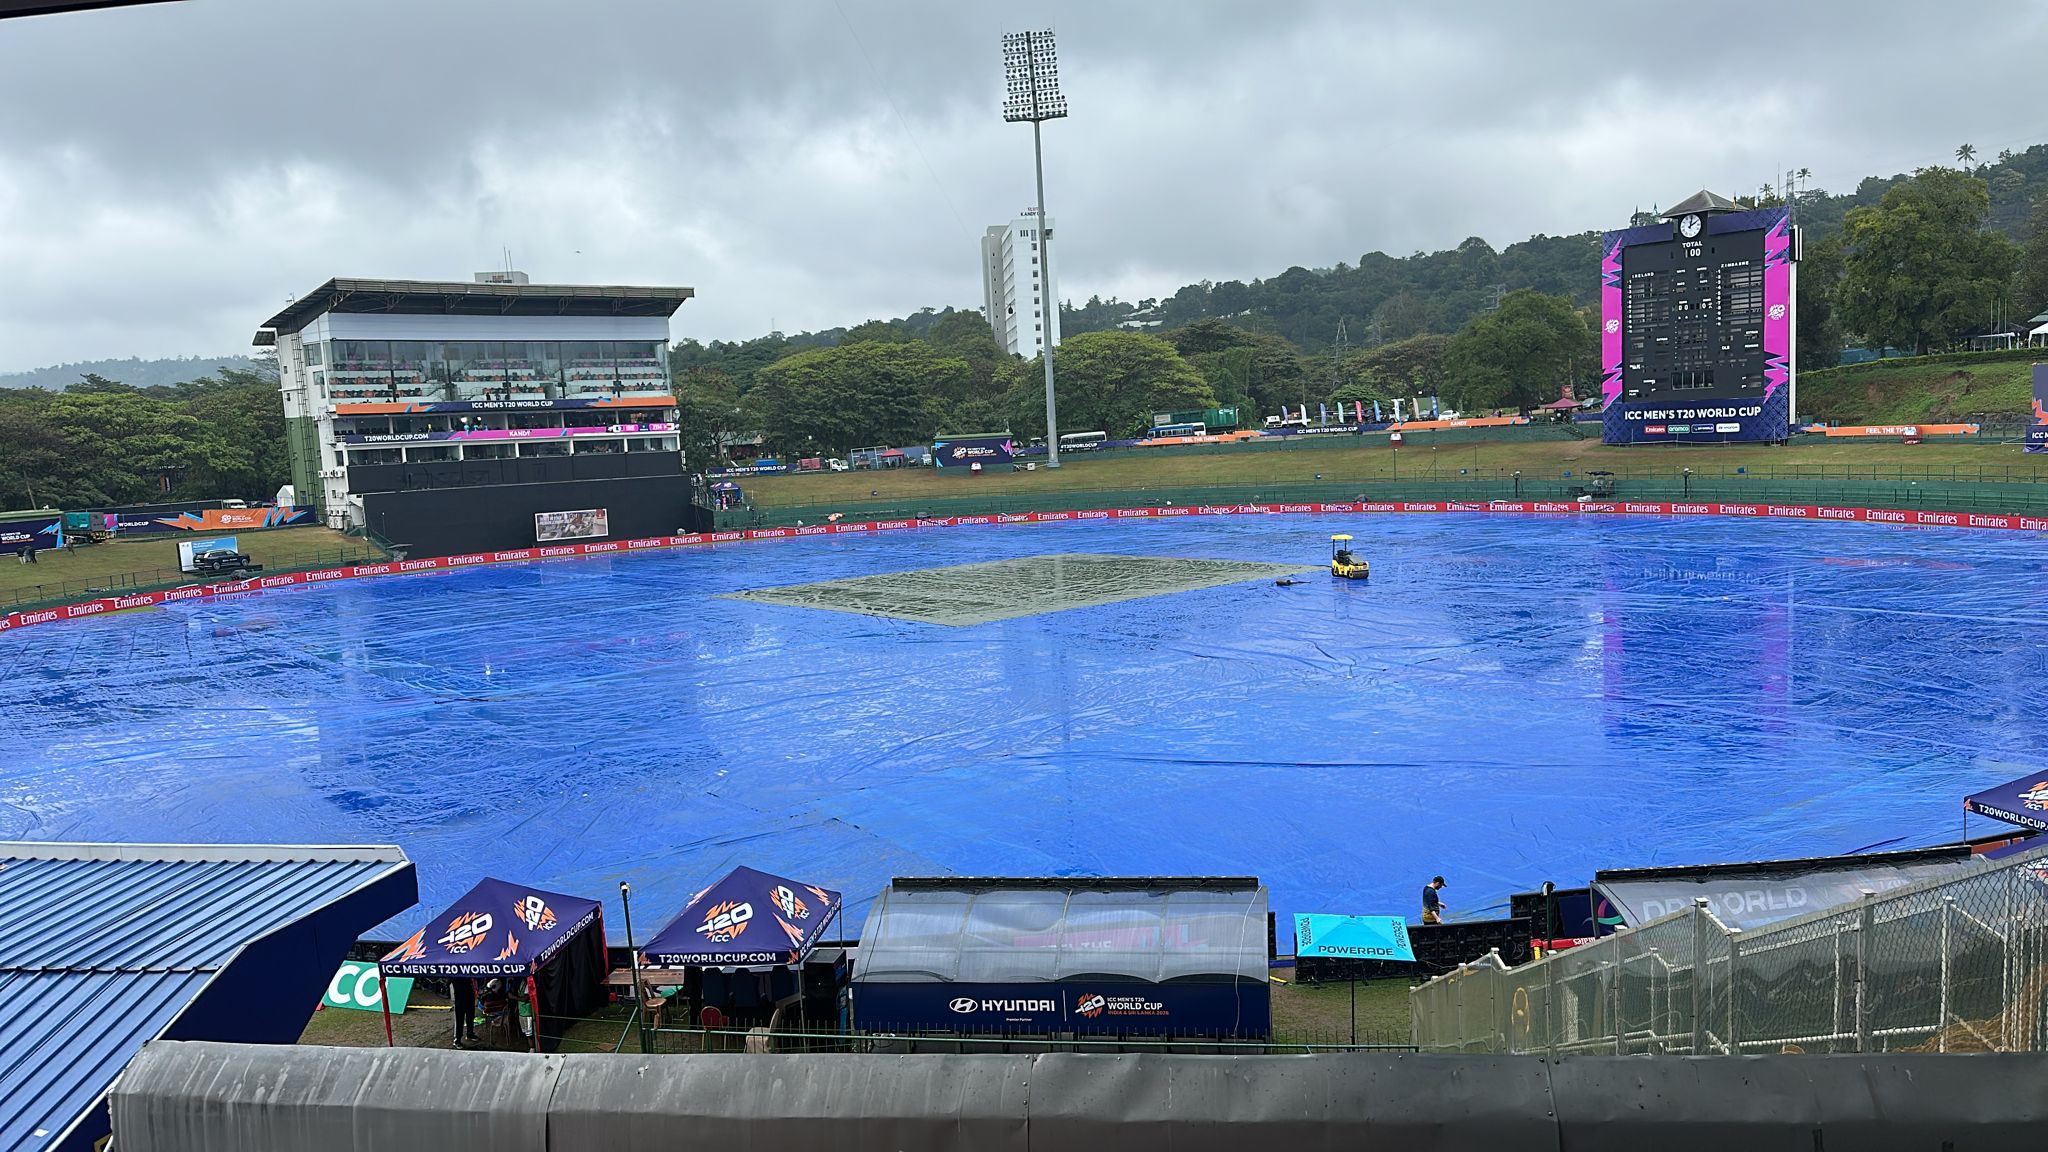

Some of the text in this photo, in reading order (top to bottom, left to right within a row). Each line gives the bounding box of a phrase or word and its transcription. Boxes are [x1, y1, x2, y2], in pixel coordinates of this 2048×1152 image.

[1624, 406, 1762, 420] ICC MEN'S T20 WORLD CUP
[364, 433, 429, 442] T20WORLDCUP.COM
[2031, 431, 2045, 439] ICC
[1117, 508, 1149, 517] Emirates
[1157, 507, 1189, 516] Emirates
[1279, 504, 1312, 513] Emirates
[1362, 503, 1395, 511] Emirates
[1404, 503, 1437, 511] Emirates
[1446, 503, 1480, 511] Emirates
[1489, 503, 1524, 512] Emirates
[1533, 503, 1569, 512] Emirates
[1579, 503, 1615, 512] Emirates
[1625, 503, 1661, 513] Emirates
[1671, 503, 1709, 514] Emirates
[1719, 504, 1757, 515] Emirates
[1768, 505, 1807, 517] Emirates
[1037, 512, 1069, 521] Emirates
[1077, 510, 1109, 519] Emirates
[1817, 507, 1855, 519] Emirates
[1866, 509, 1905, 521] Emirates
[1918, 512, 1958, 525] Emirates
[876, 520, 908, 530] Emirates
[957, 515, 989, 525] Emirates
[1969, 515, 2008, 528] Emirates
[752, 528, 785, 538] Emirates
[835, 523, 868, 533] Emirates
[628, 538, 661, 549] Emirates
[670, 534, 703, 545] Emirates
[540, 545, 575, 557] Emirates
[584, 542, 618, 553] Emirates
[448, 553, 485, 566] Emirates
[494, 550, 530, 561] Emirates
[353, 564, 390, 576] Emirates
[400, 558, 437, 571] Emirates
[306, 569, 343, 582] Emirates
[261, 575, 294, 588] Emirates
[164, 588, 203, 601] Emirates
[114, 594, 153, 609] Emirates
[67, 602, 104, 617] Emirates
[20, 610, 58, 625] Emirates
[2024, 802, 2042, 811] ICC
[695, 902, 754, 933] T20
[437, 913, 493, 944] T20
[540, 911, 594, 962] T20WORLDCUP.COM
[711, 934, 730, 943] ICC
[450, 945, 468, 954] ICC
[1318, 945, 1394, 956] POWERADE
[658, 952, 777, 964] T20WORLDCUP.COM
[382, 964, 526, 974] ICC MEN'S T20 WORLD CUP
[982, 999, 1056, 1012] HYUNDAI
[1107, 1002, 1163, 1010] WORLD CUP
